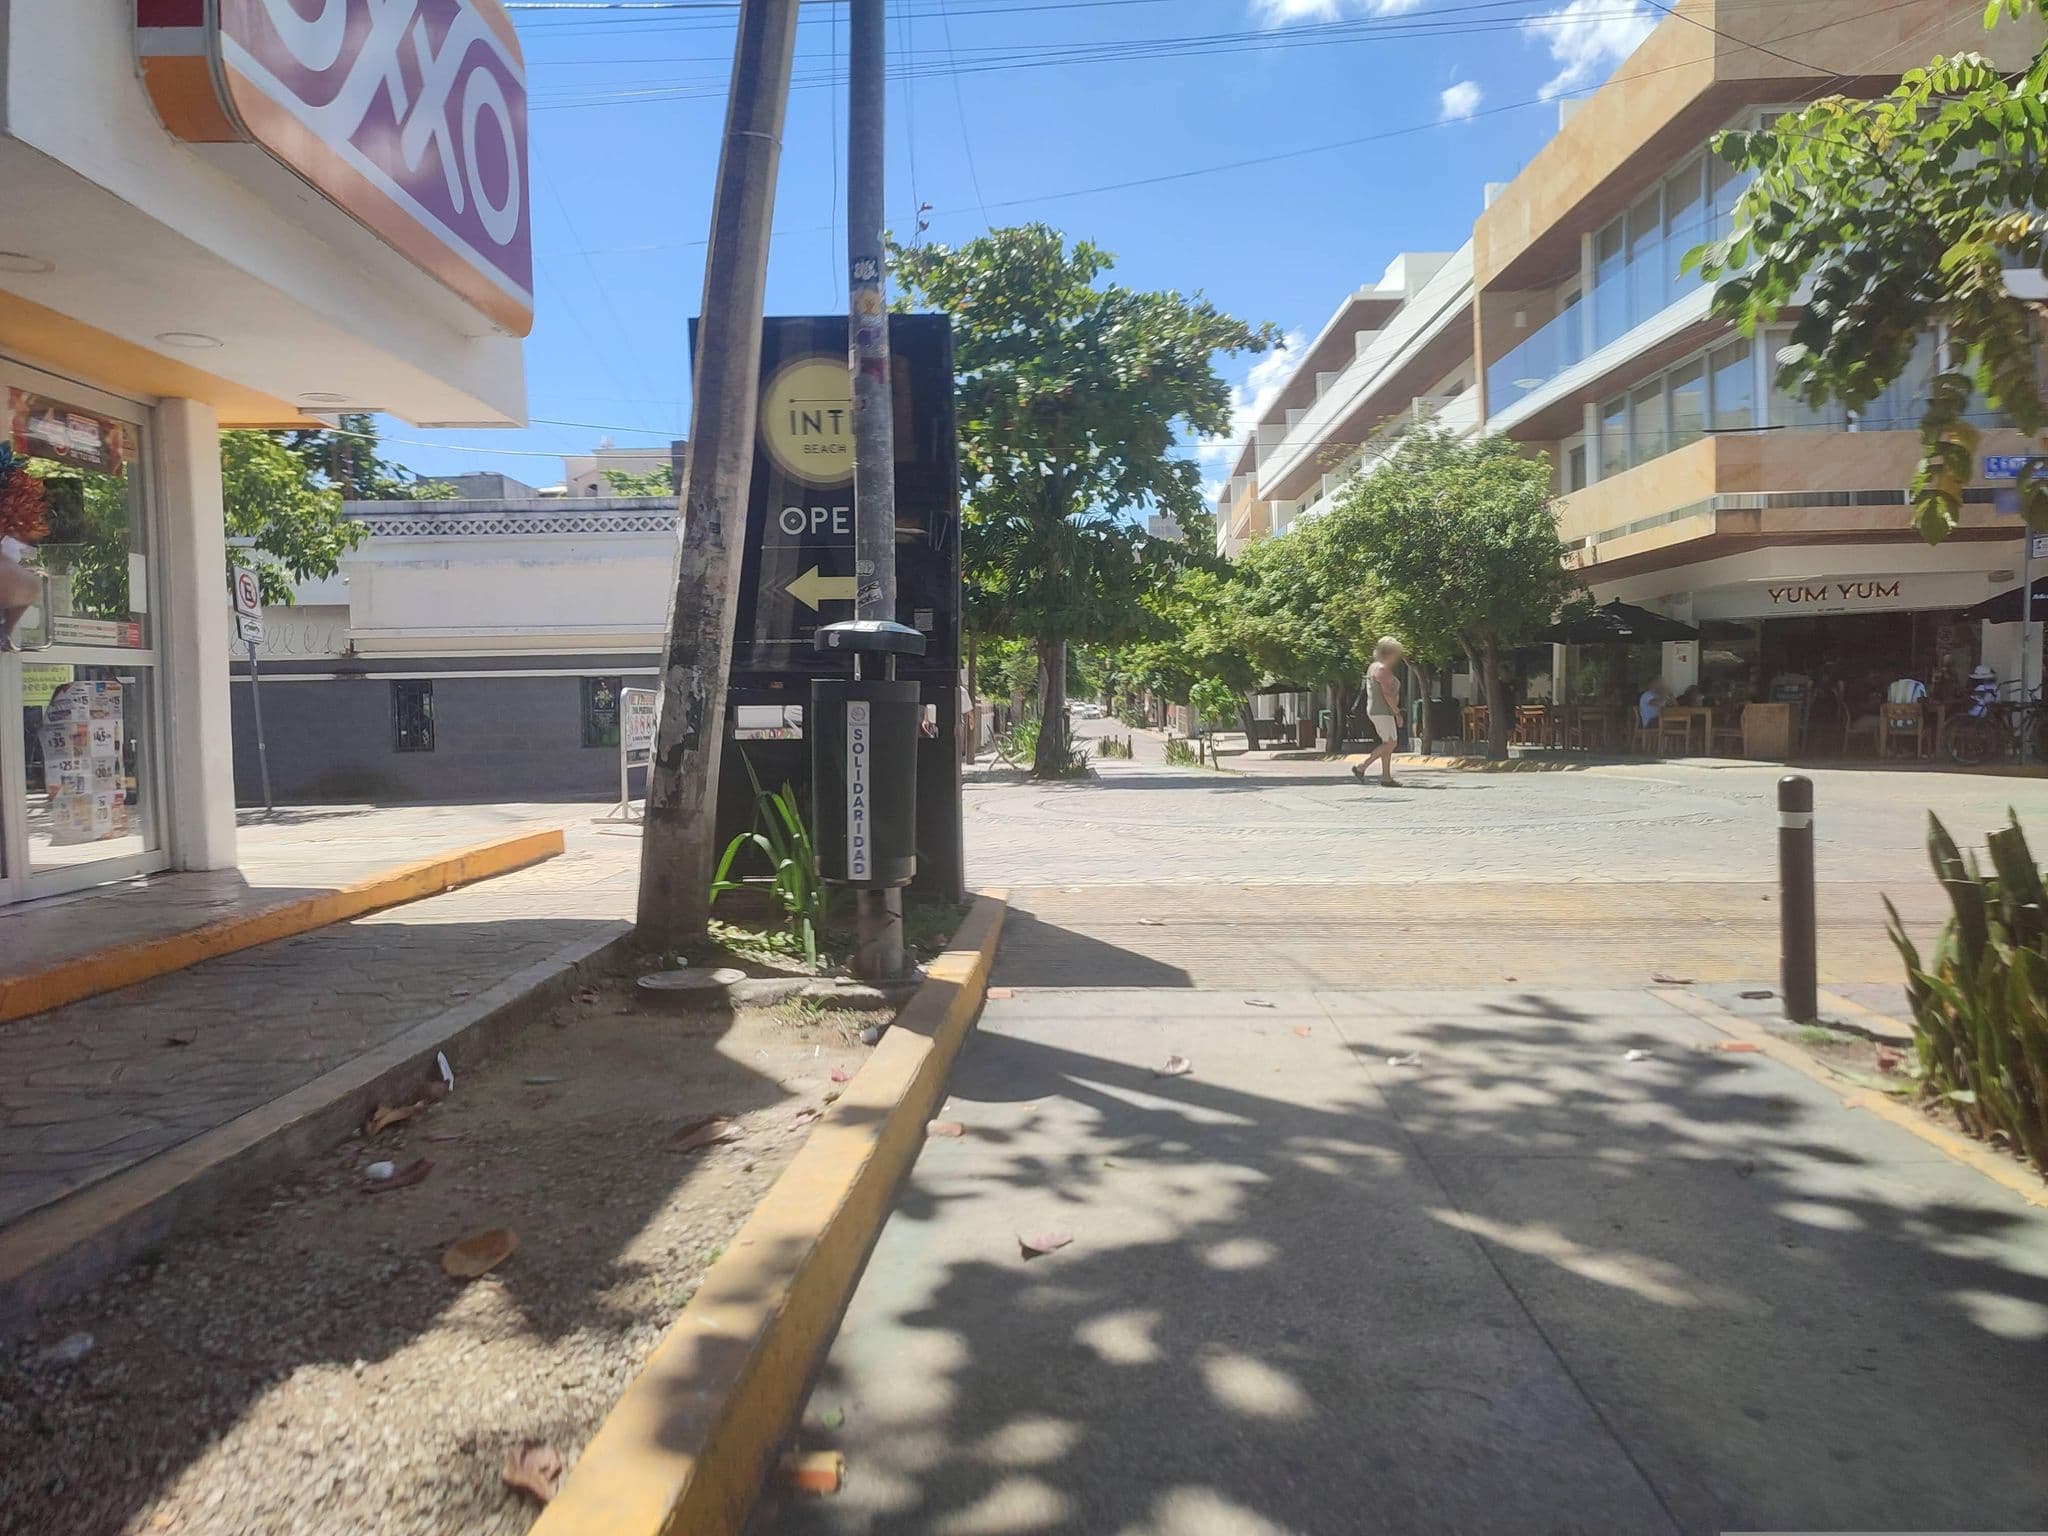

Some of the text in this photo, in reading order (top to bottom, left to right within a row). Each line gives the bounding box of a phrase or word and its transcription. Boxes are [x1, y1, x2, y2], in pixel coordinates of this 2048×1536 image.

[779, 506, 850, 536] OPE
[1767, 580, 1900, 604] YUM YUM
[852, 728, 866, 875] SOLIDARIDAD
